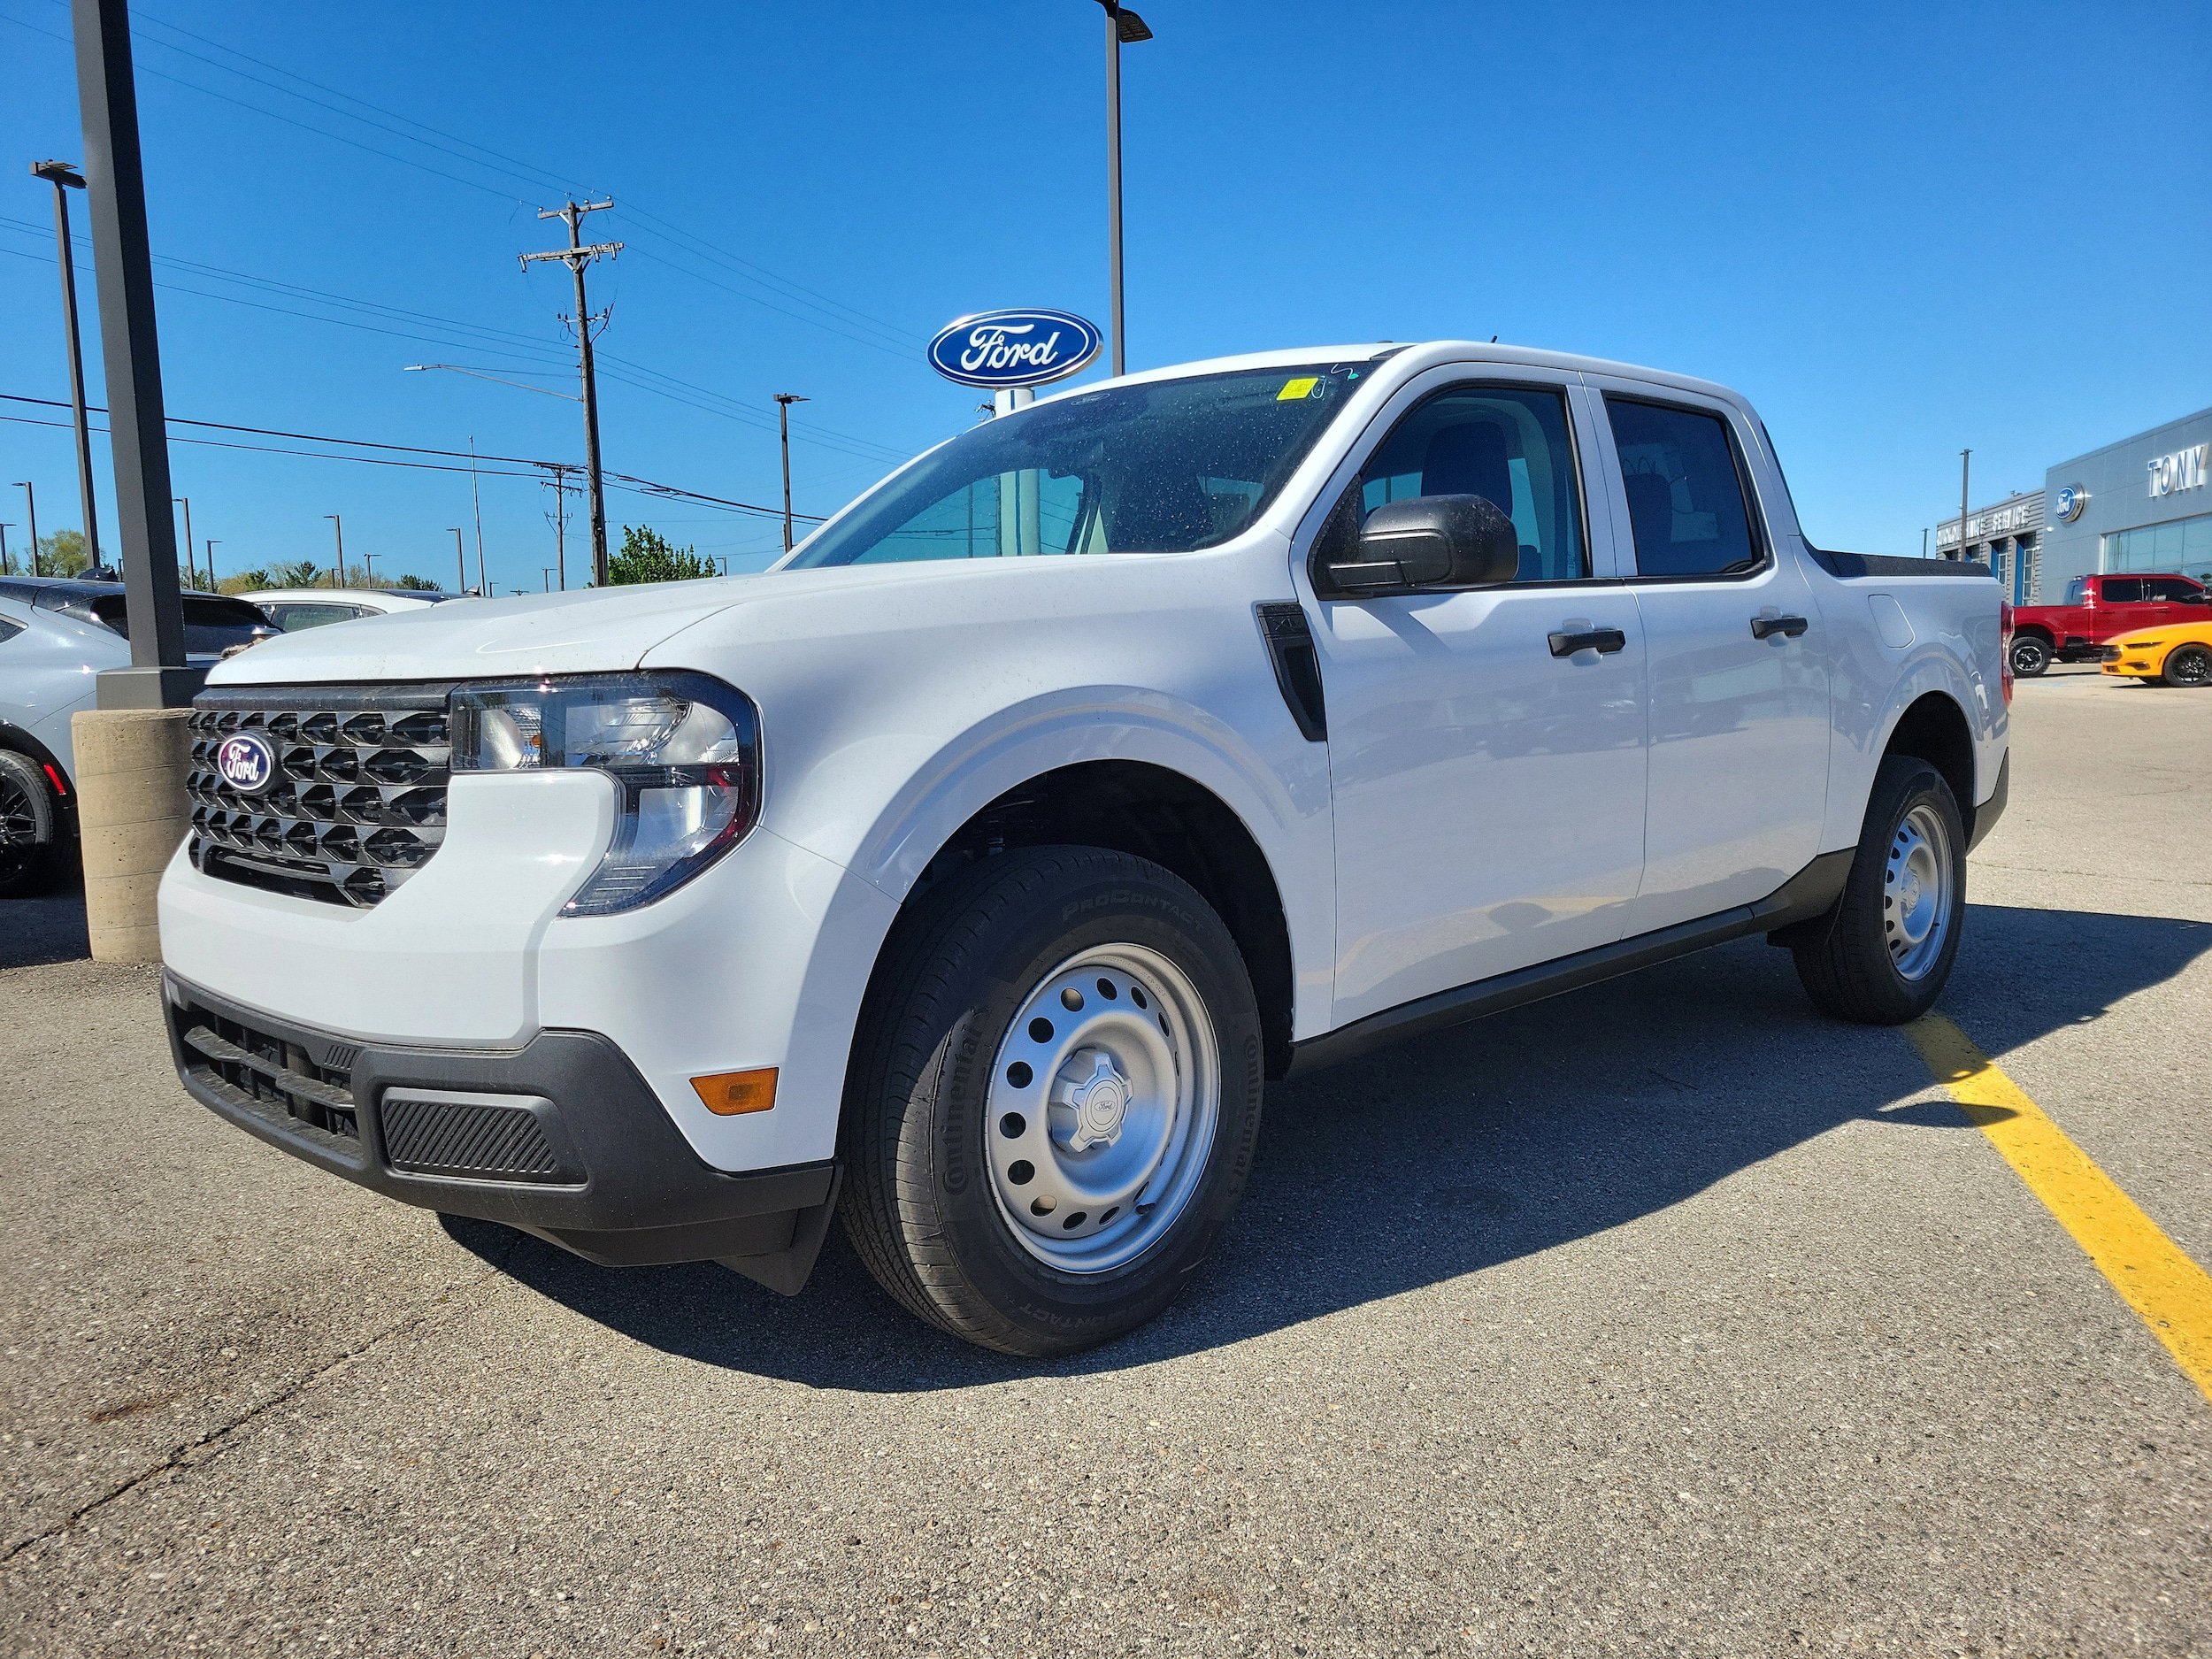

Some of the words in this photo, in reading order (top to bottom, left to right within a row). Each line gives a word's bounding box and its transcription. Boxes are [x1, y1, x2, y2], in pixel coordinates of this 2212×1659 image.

[960, 324, 1061, 371] Ford
[2147, 443, 2208, 498] TONY
[1992, 505, 2029, 532] SERVICE
[2056, 493, 2071, 514] Ford
[227, 742, 259, 781] Ford
[943, 1024, 984, 1194] Continental
